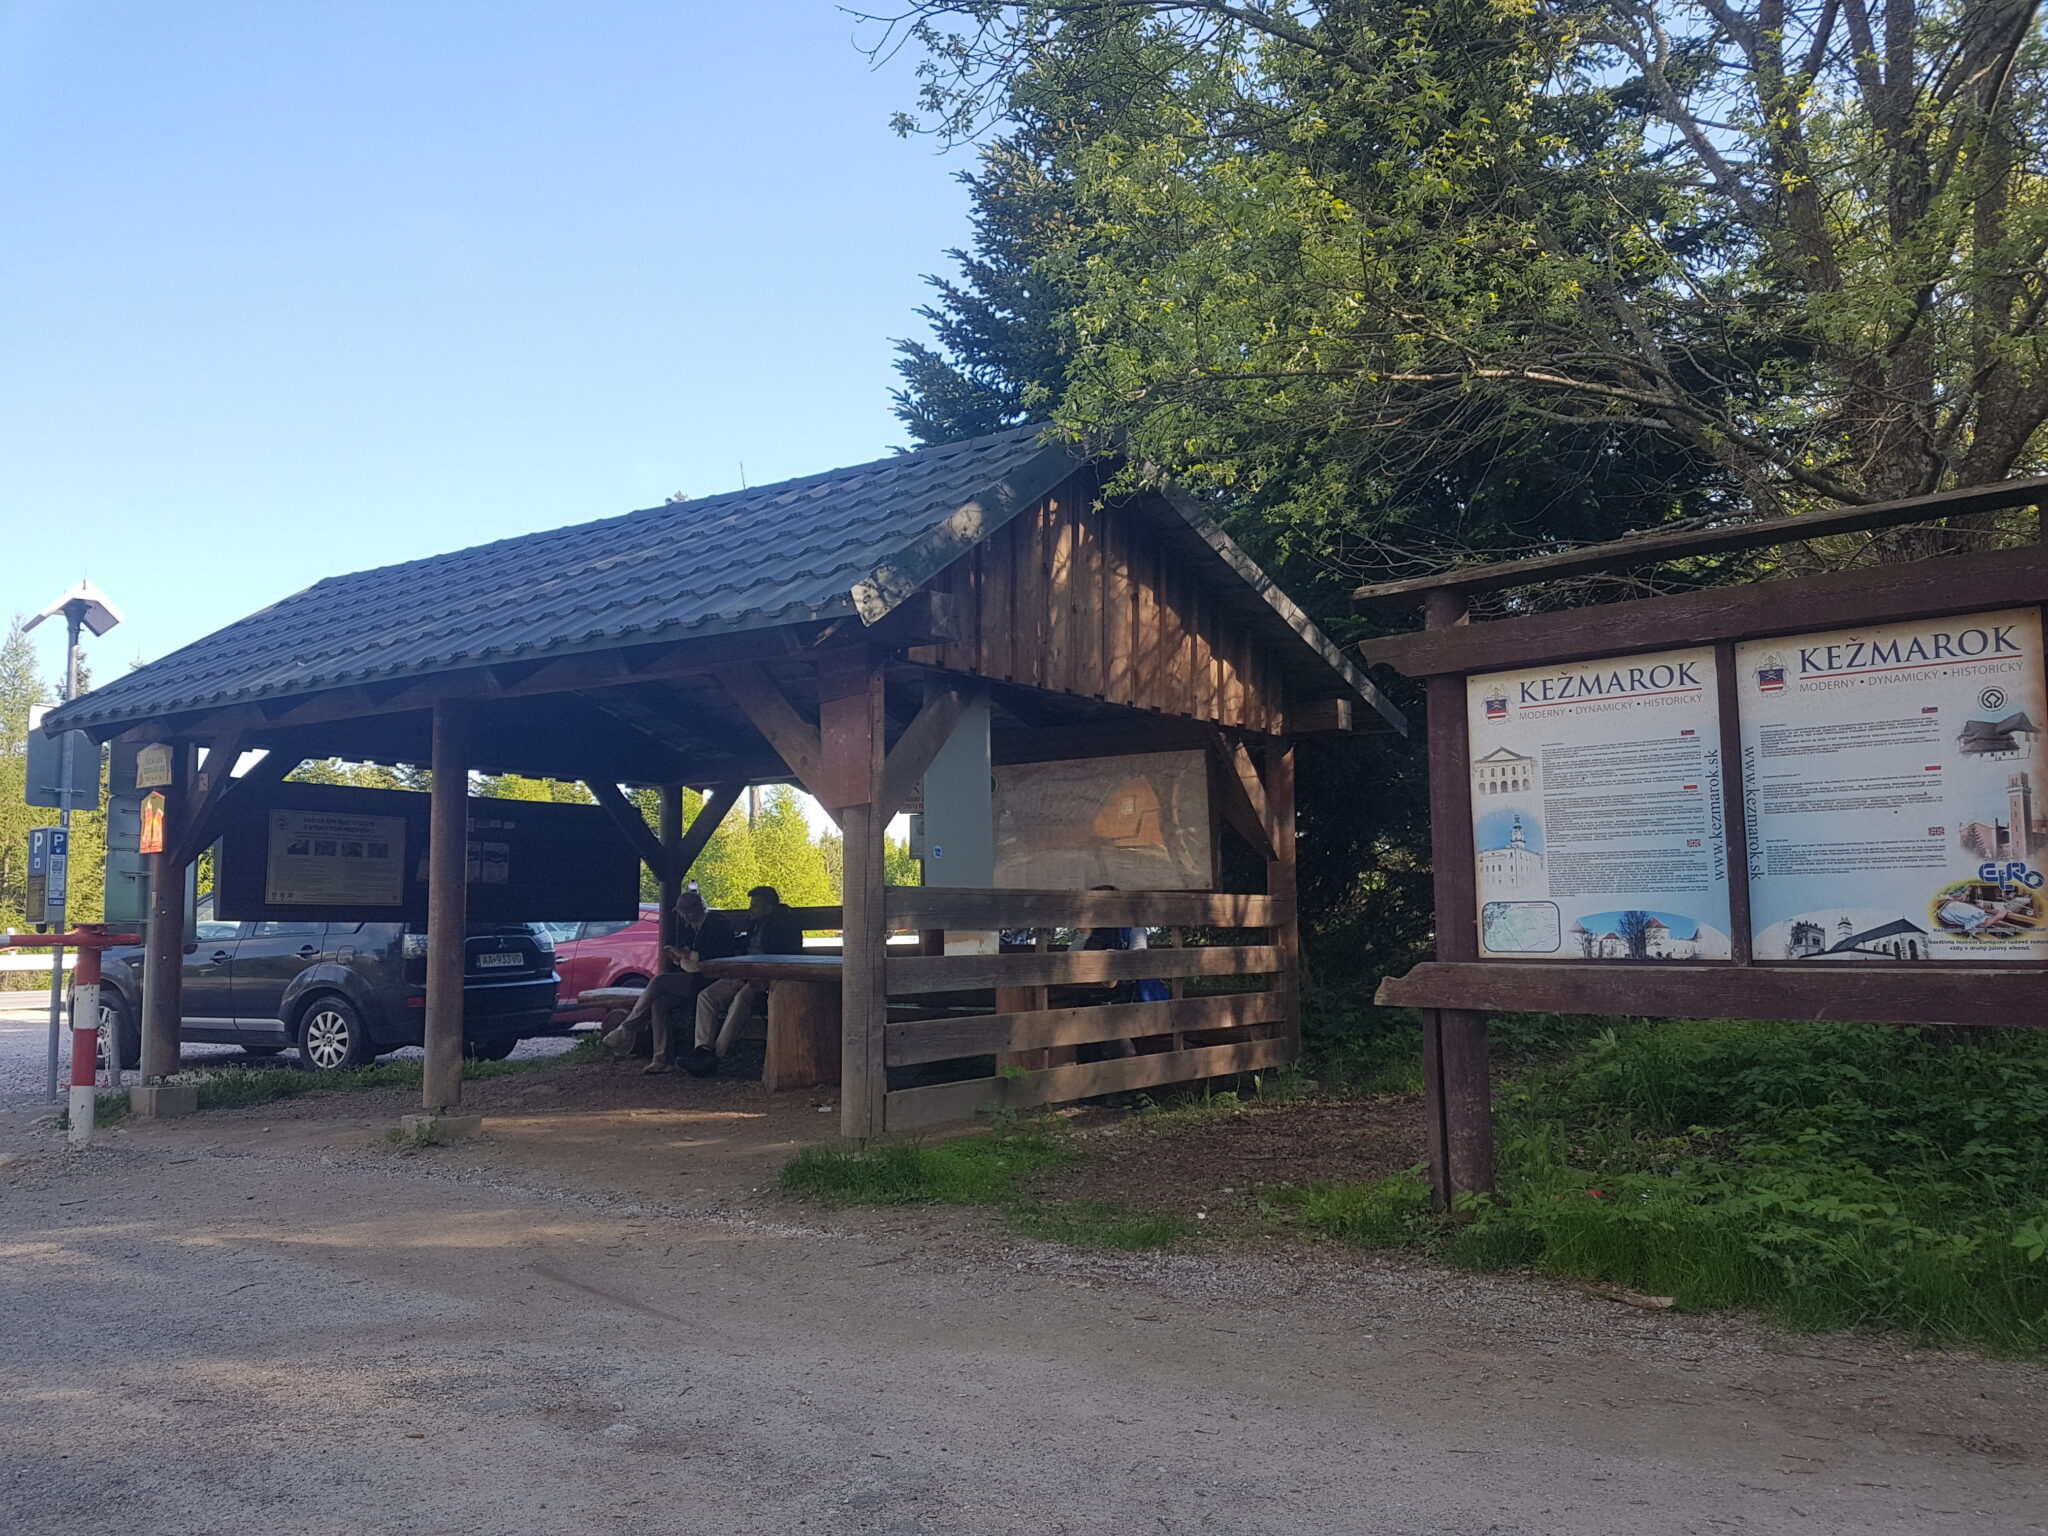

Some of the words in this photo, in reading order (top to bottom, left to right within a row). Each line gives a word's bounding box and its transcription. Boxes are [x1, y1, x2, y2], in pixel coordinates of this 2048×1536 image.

[1798, 624, 2023, 674] KEŽMAROK
[1519, 661, 1701, 703] KEŽMAROK
[1799, 677, 1856, 692] MODERNÝ
[1868, 669, 1939, 686] DYNAMICKÝ
[1951, 661, 2025, 677] HISTORICKÝ
[1519, 707, 1565, 721] MODERNÝ
[1575, 700, 1634, 715] DYNAMICKÝ
[1643, 693, 1703, 708] HISTORICKÝ
[1704, 749, 1725, 881] www.kezmarok.sk
[1744, 746, 1765, 880] www.kezmarok.sk
[33, 831, 43, 854] P
[54, 834, 64, 847] P
